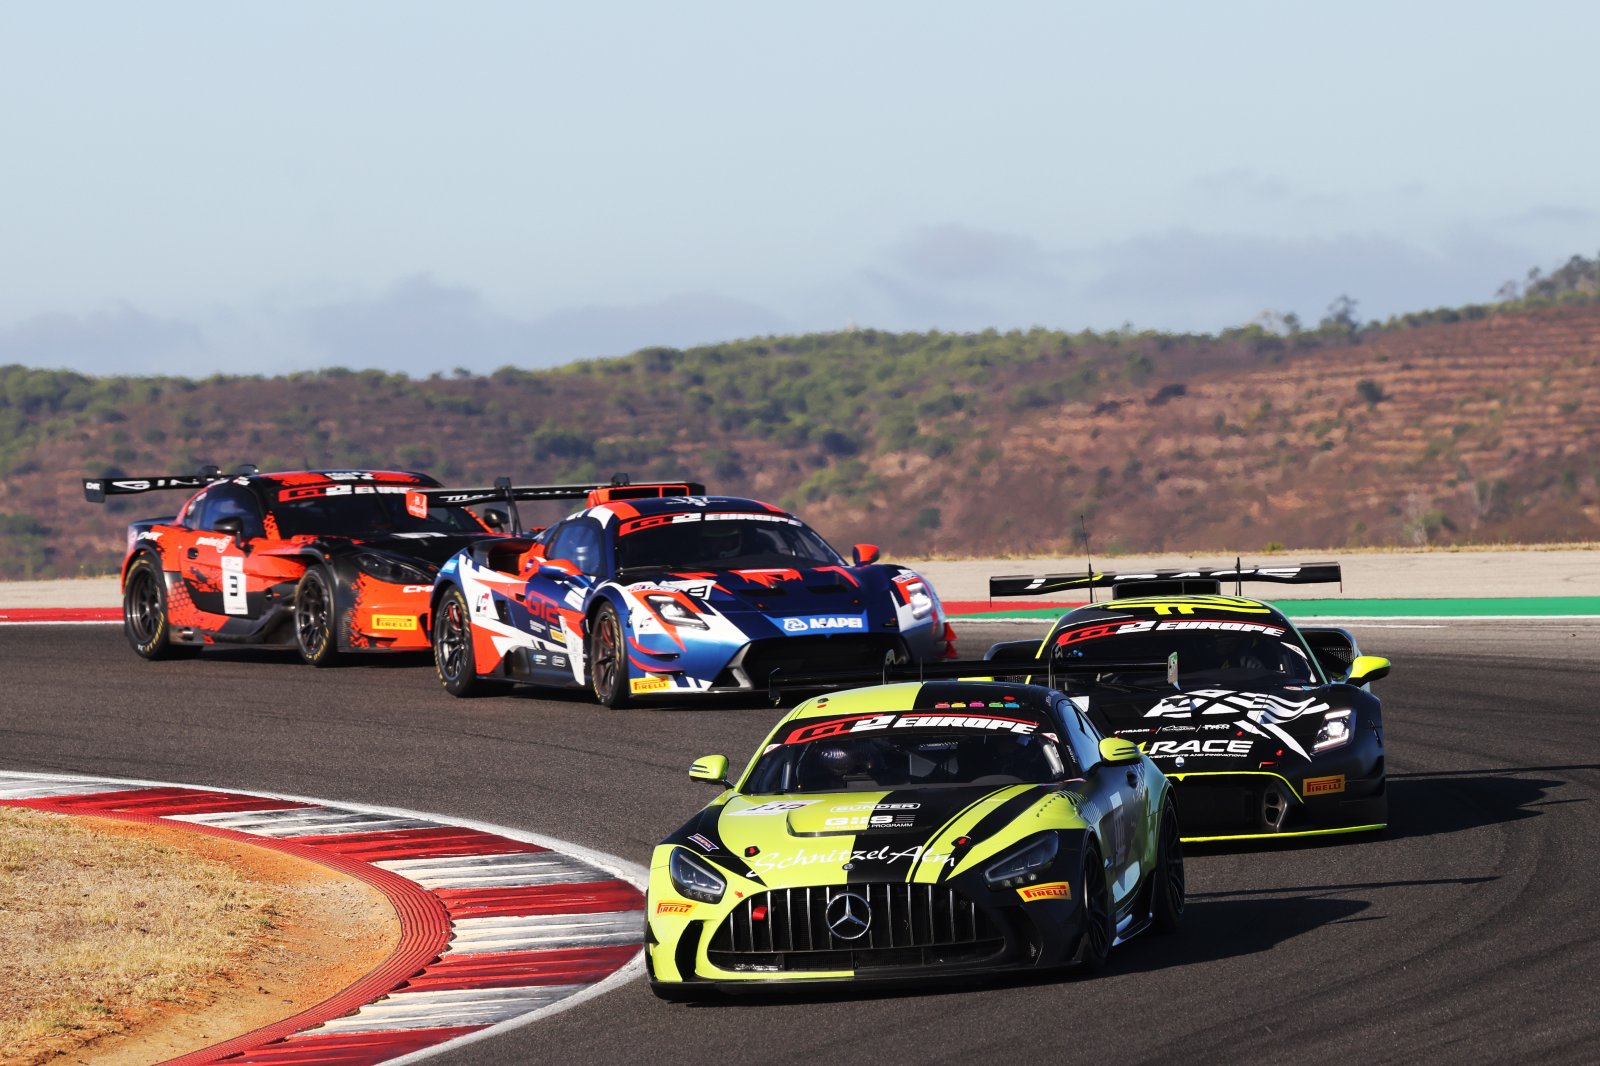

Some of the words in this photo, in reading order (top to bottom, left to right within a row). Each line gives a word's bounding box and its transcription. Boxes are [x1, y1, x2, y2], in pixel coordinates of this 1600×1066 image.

[704, 513, 803, 527] EUROPE
[229, 575, 238, 597] 3
[527, 590, 560, 625] GT2
[376, 617, 413, 628] PIRELLI
[809, 616, 864, 630] MAPEI
[1156, 620, 1286, 637] EUROPE
[633, 678, 667, 691] PIRELLI
[892, 715, 1041, 736] EUROPE
[1306, 778, 1342, 793] PIRELLI
[1023, 883, 1068, 899] PIRELLI
[656, 902, 693, 915] PIRELLI
